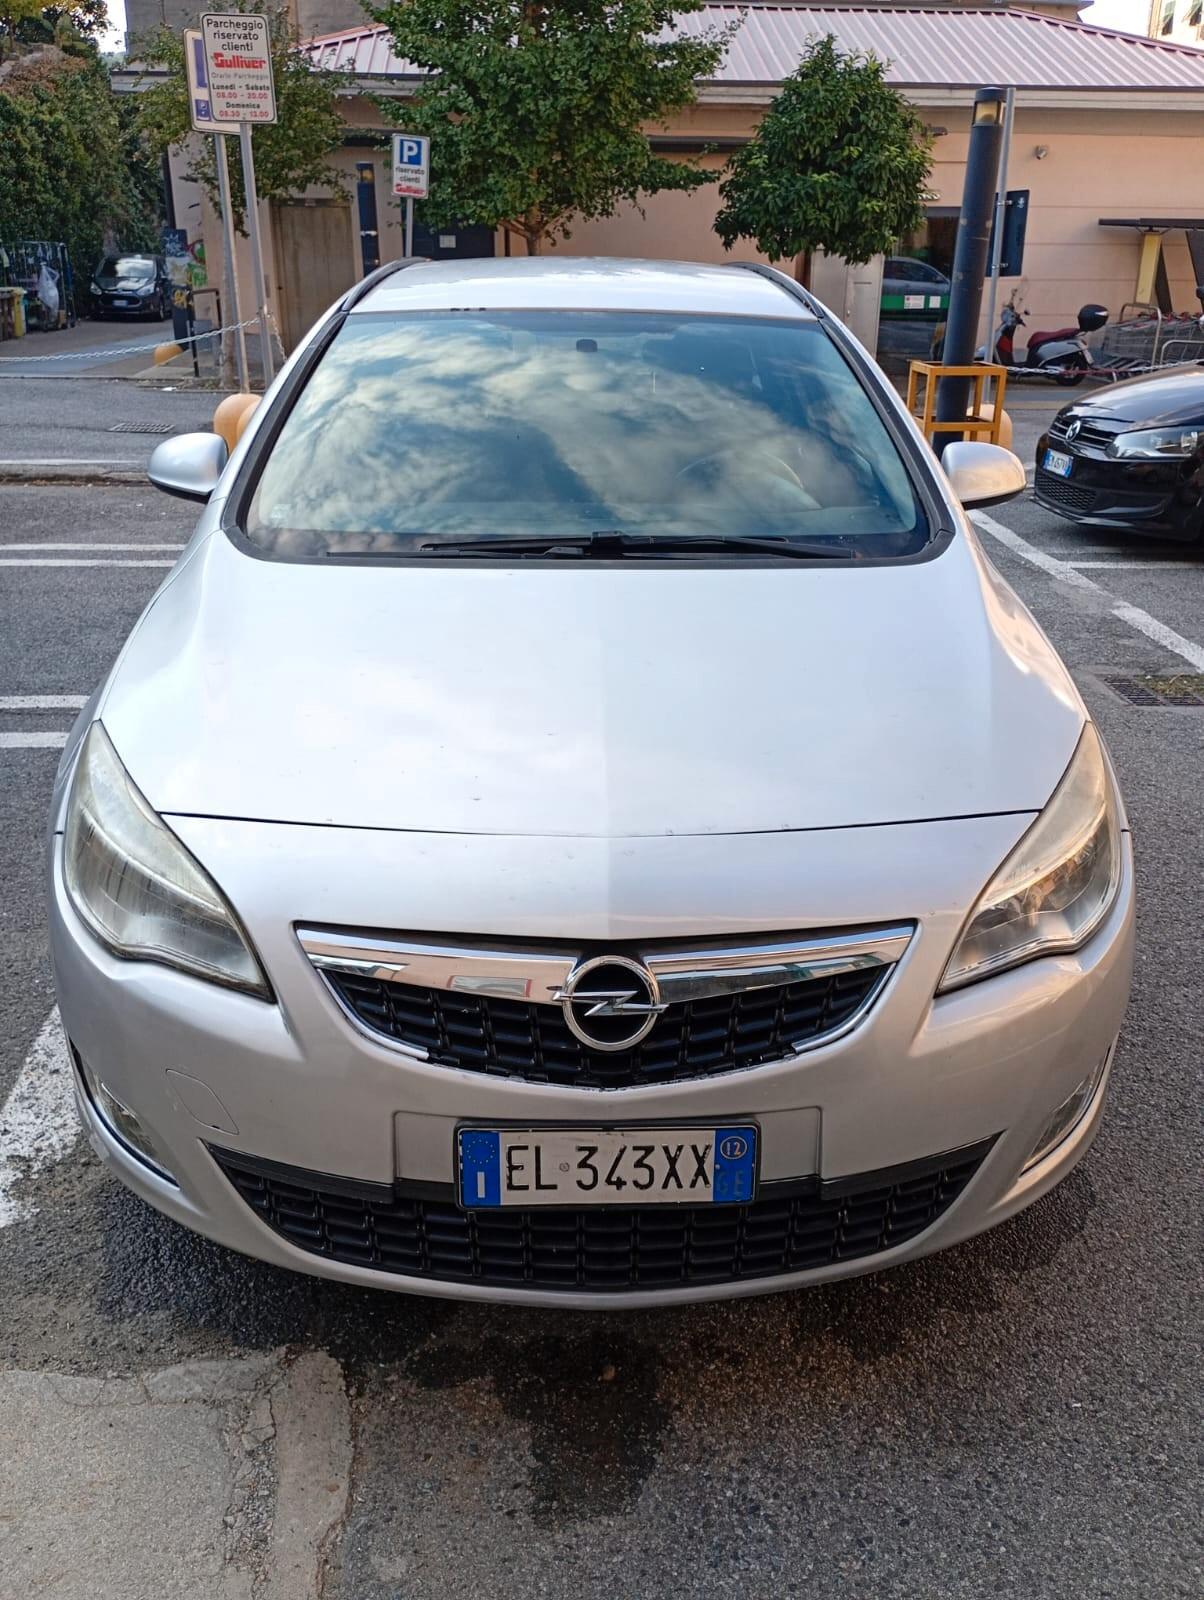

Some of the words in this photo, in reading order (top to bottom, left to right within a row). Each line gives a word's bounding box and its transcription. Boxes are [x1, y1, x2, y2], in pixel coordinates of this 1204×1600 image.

[206, 18, 263, 31] Parcheggio
[213, 30, 259, 41] riservato
[221, 42, 253, 51] clienti
[245, 83, 270, 91] Sabato
[403, 141, 418, 162] P
[726, 1141, 742, 1156] 12
[506, 1145, 558, 1191] EL
[575, 1144, 713, 1191] 343XX
